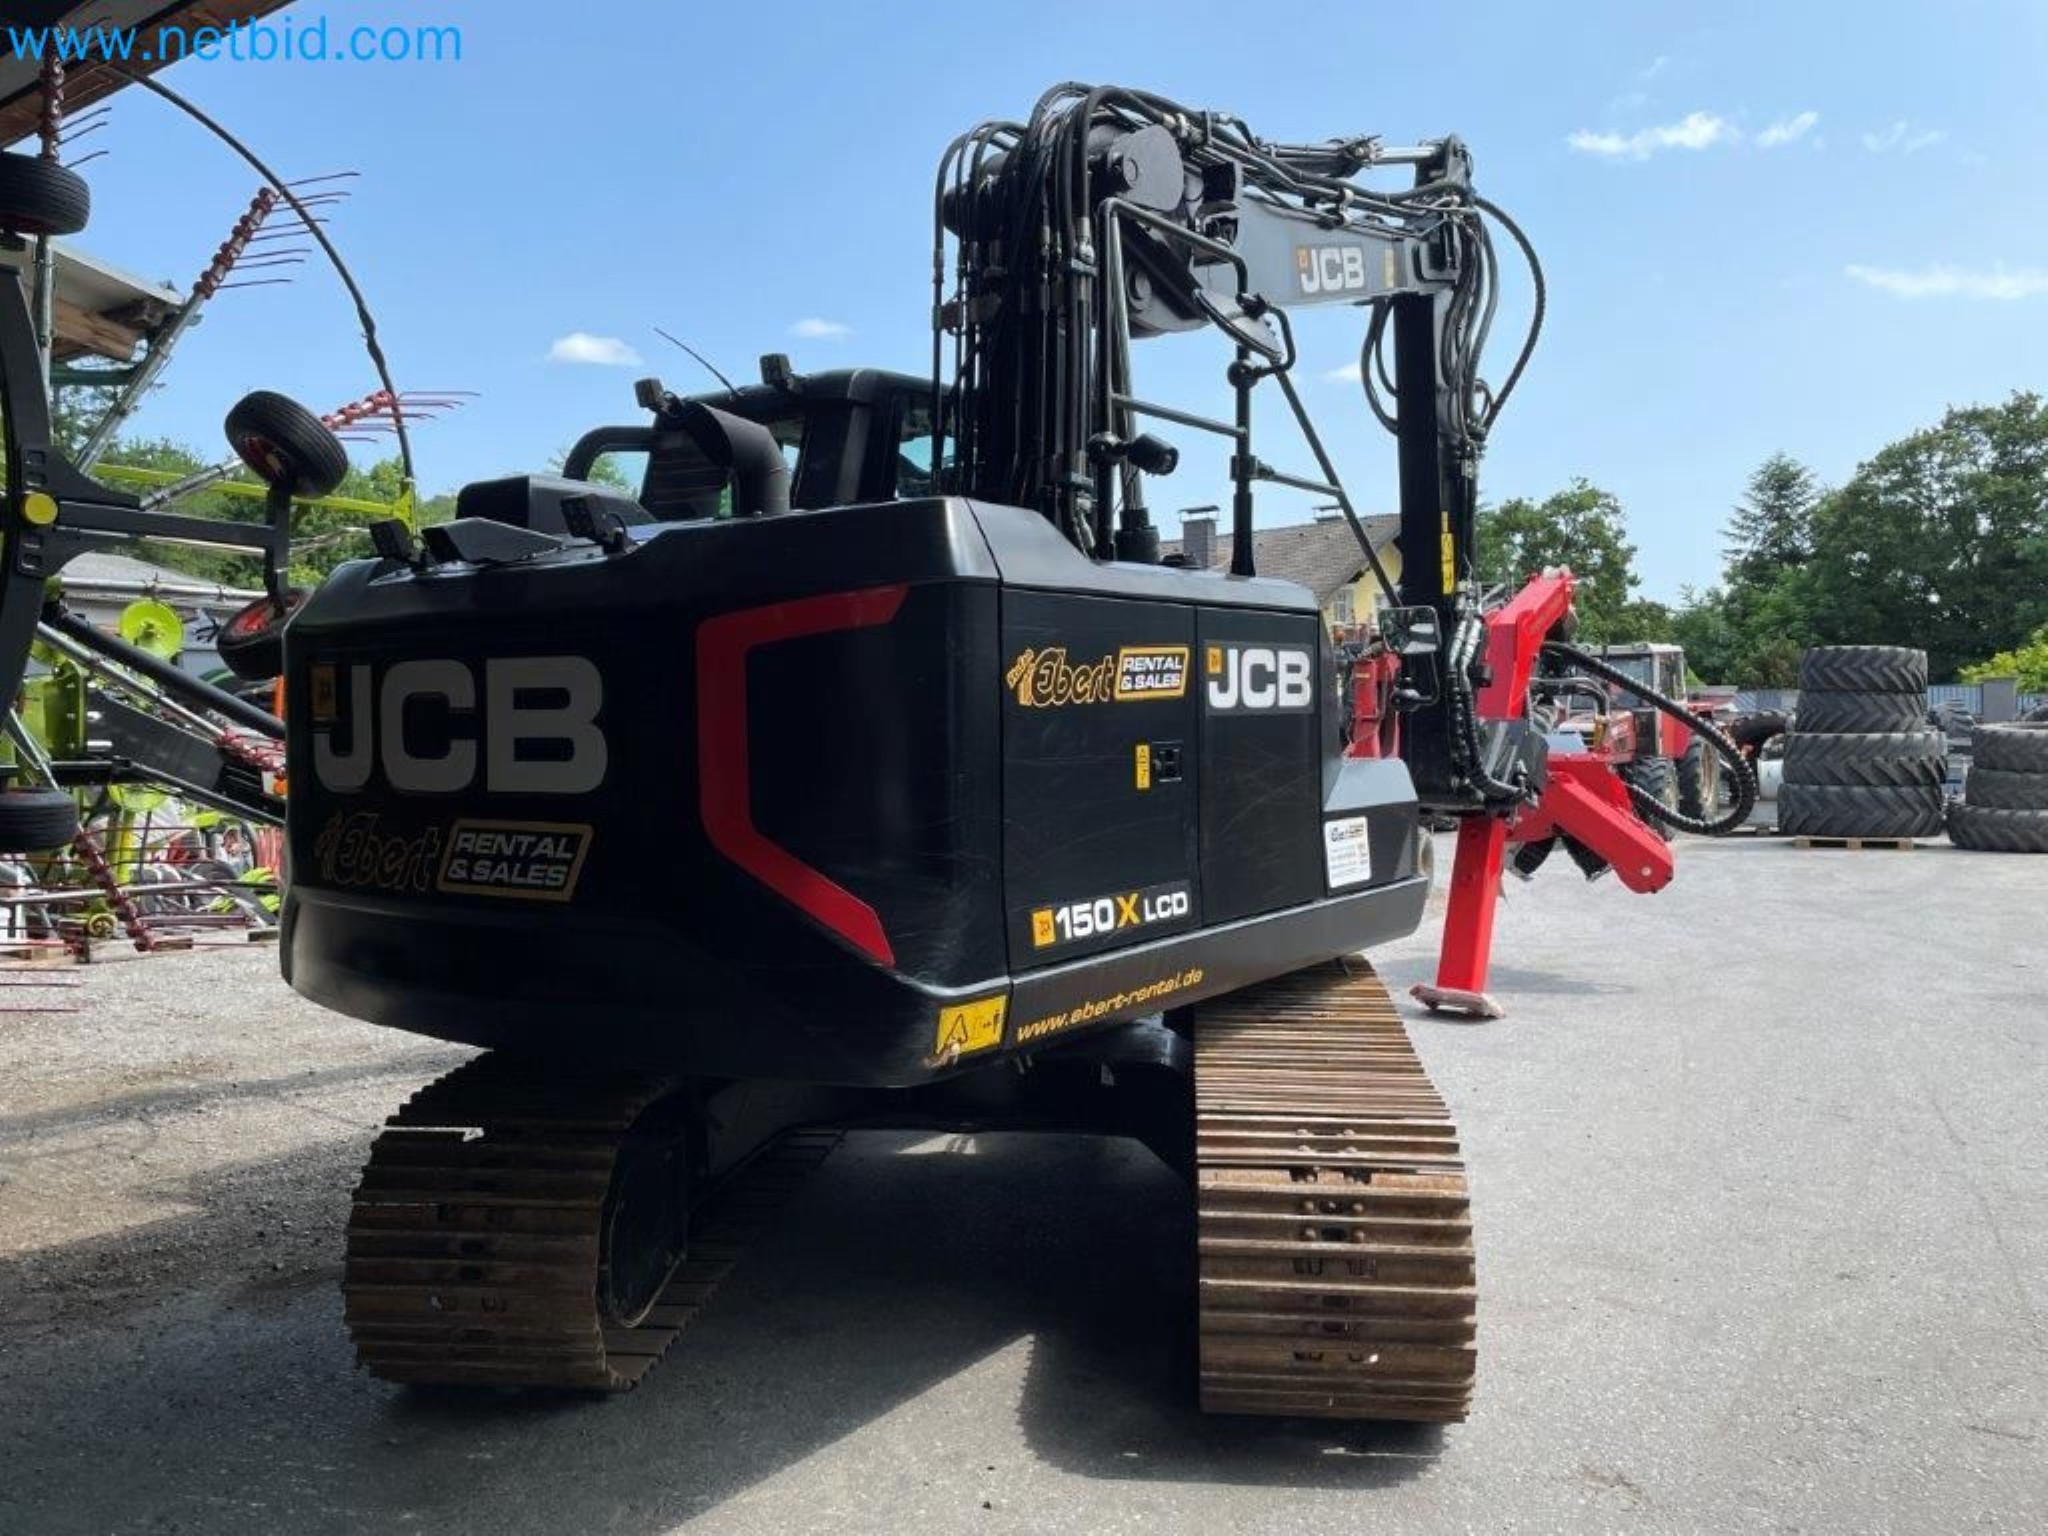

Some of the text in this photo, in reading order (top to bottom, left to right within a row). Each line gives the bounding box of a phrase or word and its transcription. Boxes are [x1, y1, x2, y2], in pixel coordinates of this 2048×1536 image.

[1300, 246, 1365, 294] JCB
[1031, 647, 1115, 708] Ebert
[1123, 656, 1183, 673] RENTAL
[1135, 672, 1181, 690] SALES
[1207, 647, 1313, 709] JCB
[312, 655, 609, 794] JCB
[455, 831, 574, 859] RENTAL
[472, 861, 568, 887] SALES
[1143, 891, 1189, 923] LCD
[1016, 968, 1204, 1043] www.ebert-rental.de
